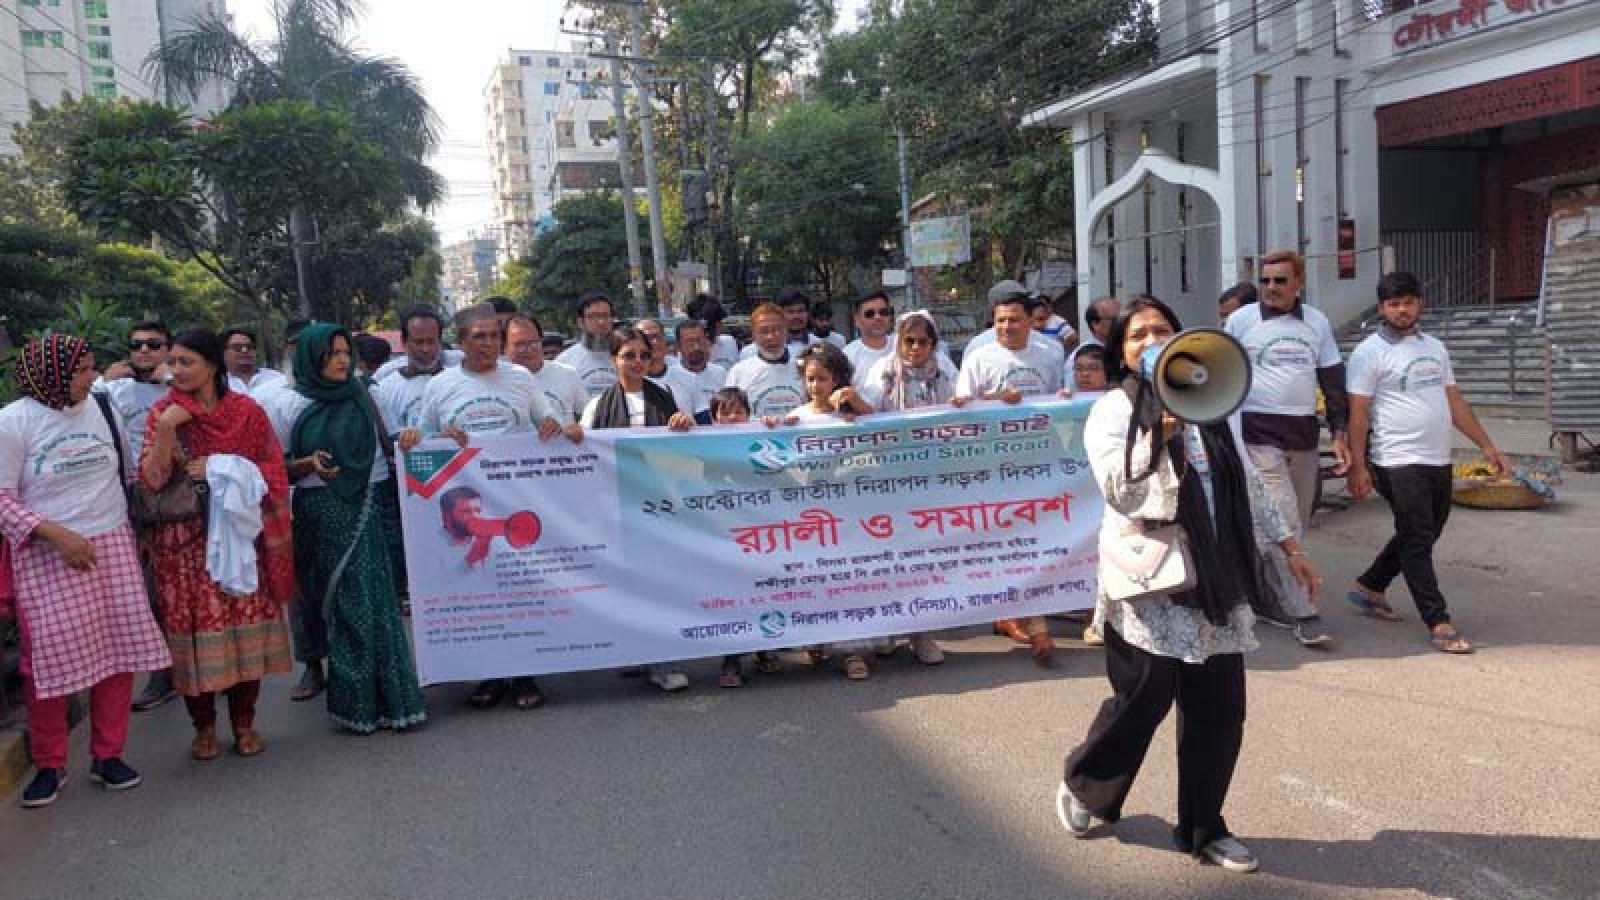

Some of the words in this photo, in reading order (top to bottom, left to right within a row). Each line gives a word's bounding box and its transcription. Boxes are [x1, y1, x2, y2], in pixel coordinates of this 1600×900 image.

[796, 429, 899, 453] নিরাপদ
[911, 423, 987, 442] সড়ক
[1000, 413, 1050, 432] চাই
[799, 460, 830, 470] We
[839, 450, 929, 467] Demand
[937, 445, 987, 459] Safe
[993, 439, 1049, 454] Road
[642, 499, 676, 516] ২২
[682, 489, 771, 511] অক্টোবর
[781, 479, 848, 502] জাতীয়
[853, 475, 929, 495] নিরাপদ
[936, 469, 992, 490] সড়ক
[1000, 462, 1052, 482] দিবস
[729, 508, 844, 554] র‍্যালী
[859, 513, 895, 540] ও
[908, 491, 1075, 535] সমাবেশ
[852, 549, 895, 564] রাজশাহী
[898, 547, 925, 560] জেলা
[791, 610, 839, 625] নিরাপদ
[843, 606, 876, 622] সড়ক
[880, 601, 902, 617] চাই
[966, 585, 1019, 607] রাজশাহী
[1024, 583, 1055, 600] জেলা
[1057, 579, 1091, 595] শাখা,
